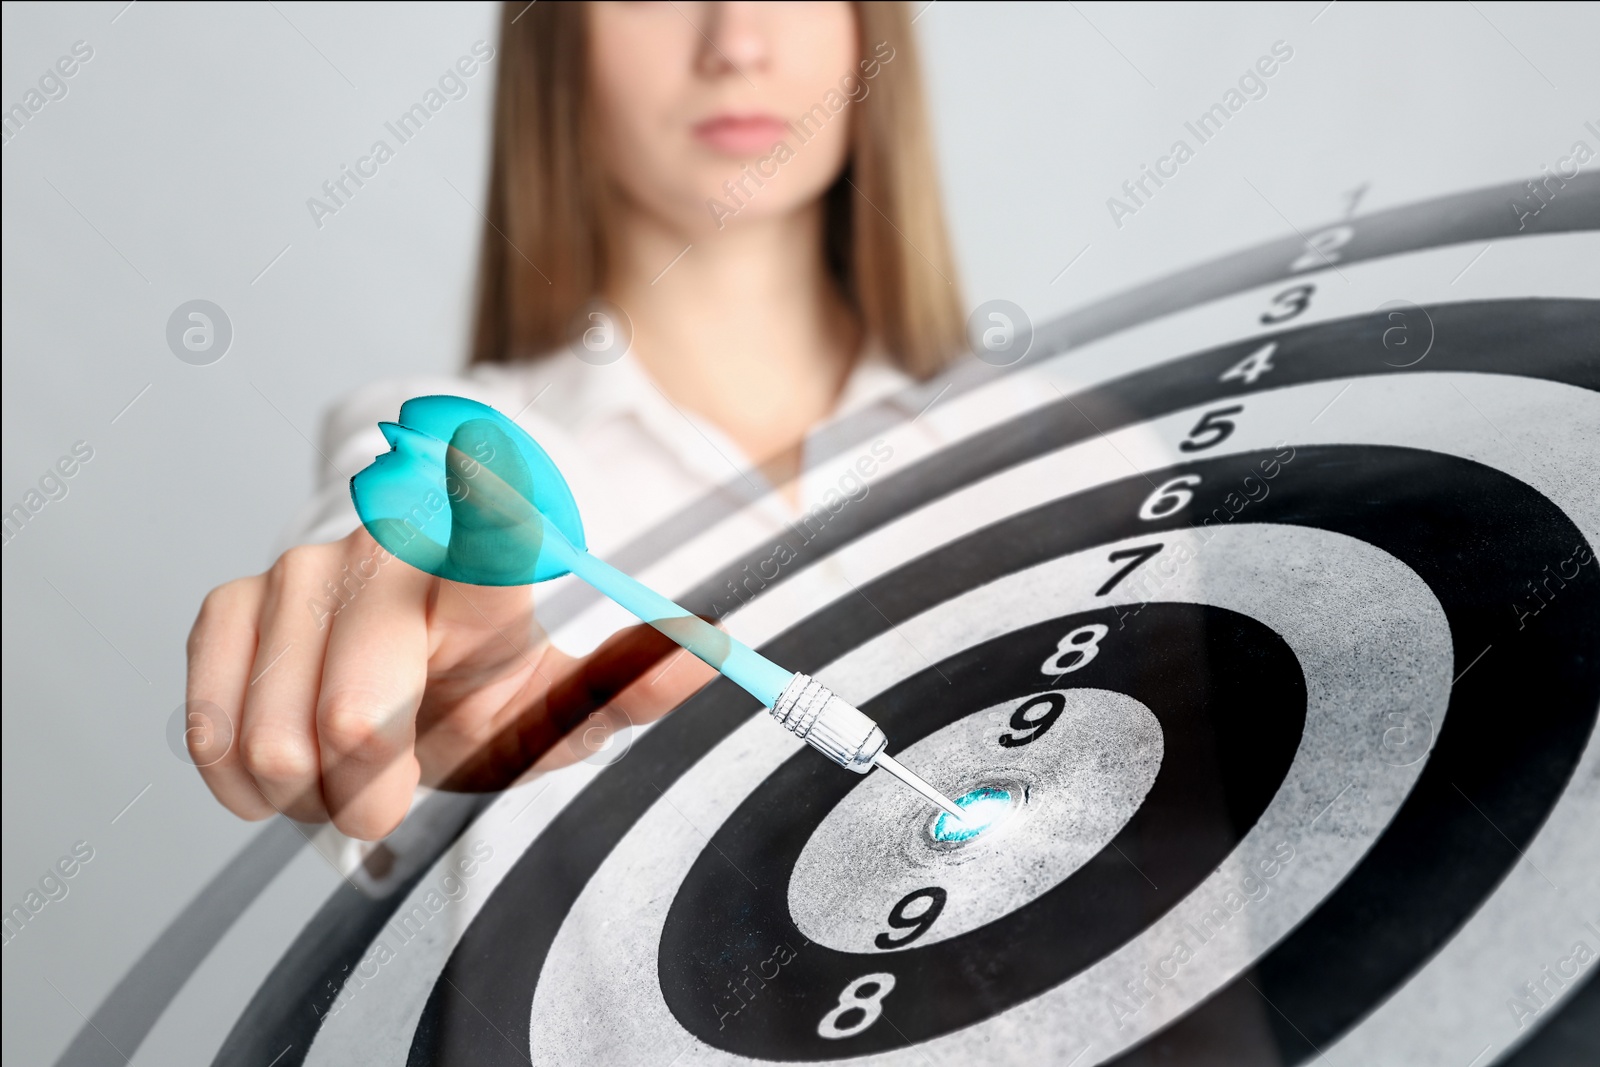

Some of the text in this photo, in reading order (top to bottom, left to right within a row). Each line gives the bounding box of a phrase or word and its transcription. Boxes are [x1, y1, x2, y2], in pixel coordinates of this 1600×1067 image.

[1291, 225, 1354, 270] 2
[1259, 283, 1316, 325] 3
[1219, 342, 1277, 384] 4
[1179, 404, 1244, 453] 5
[1138, 474, 1202, 521] 6
[1094, 543, 1164, 597] 7
[1041, 623, 1109, 676] 8
[998, 692, 1066, 748] 9
[874, 886, 947, 950] 9
[817, 972, 896, 1040] 8
